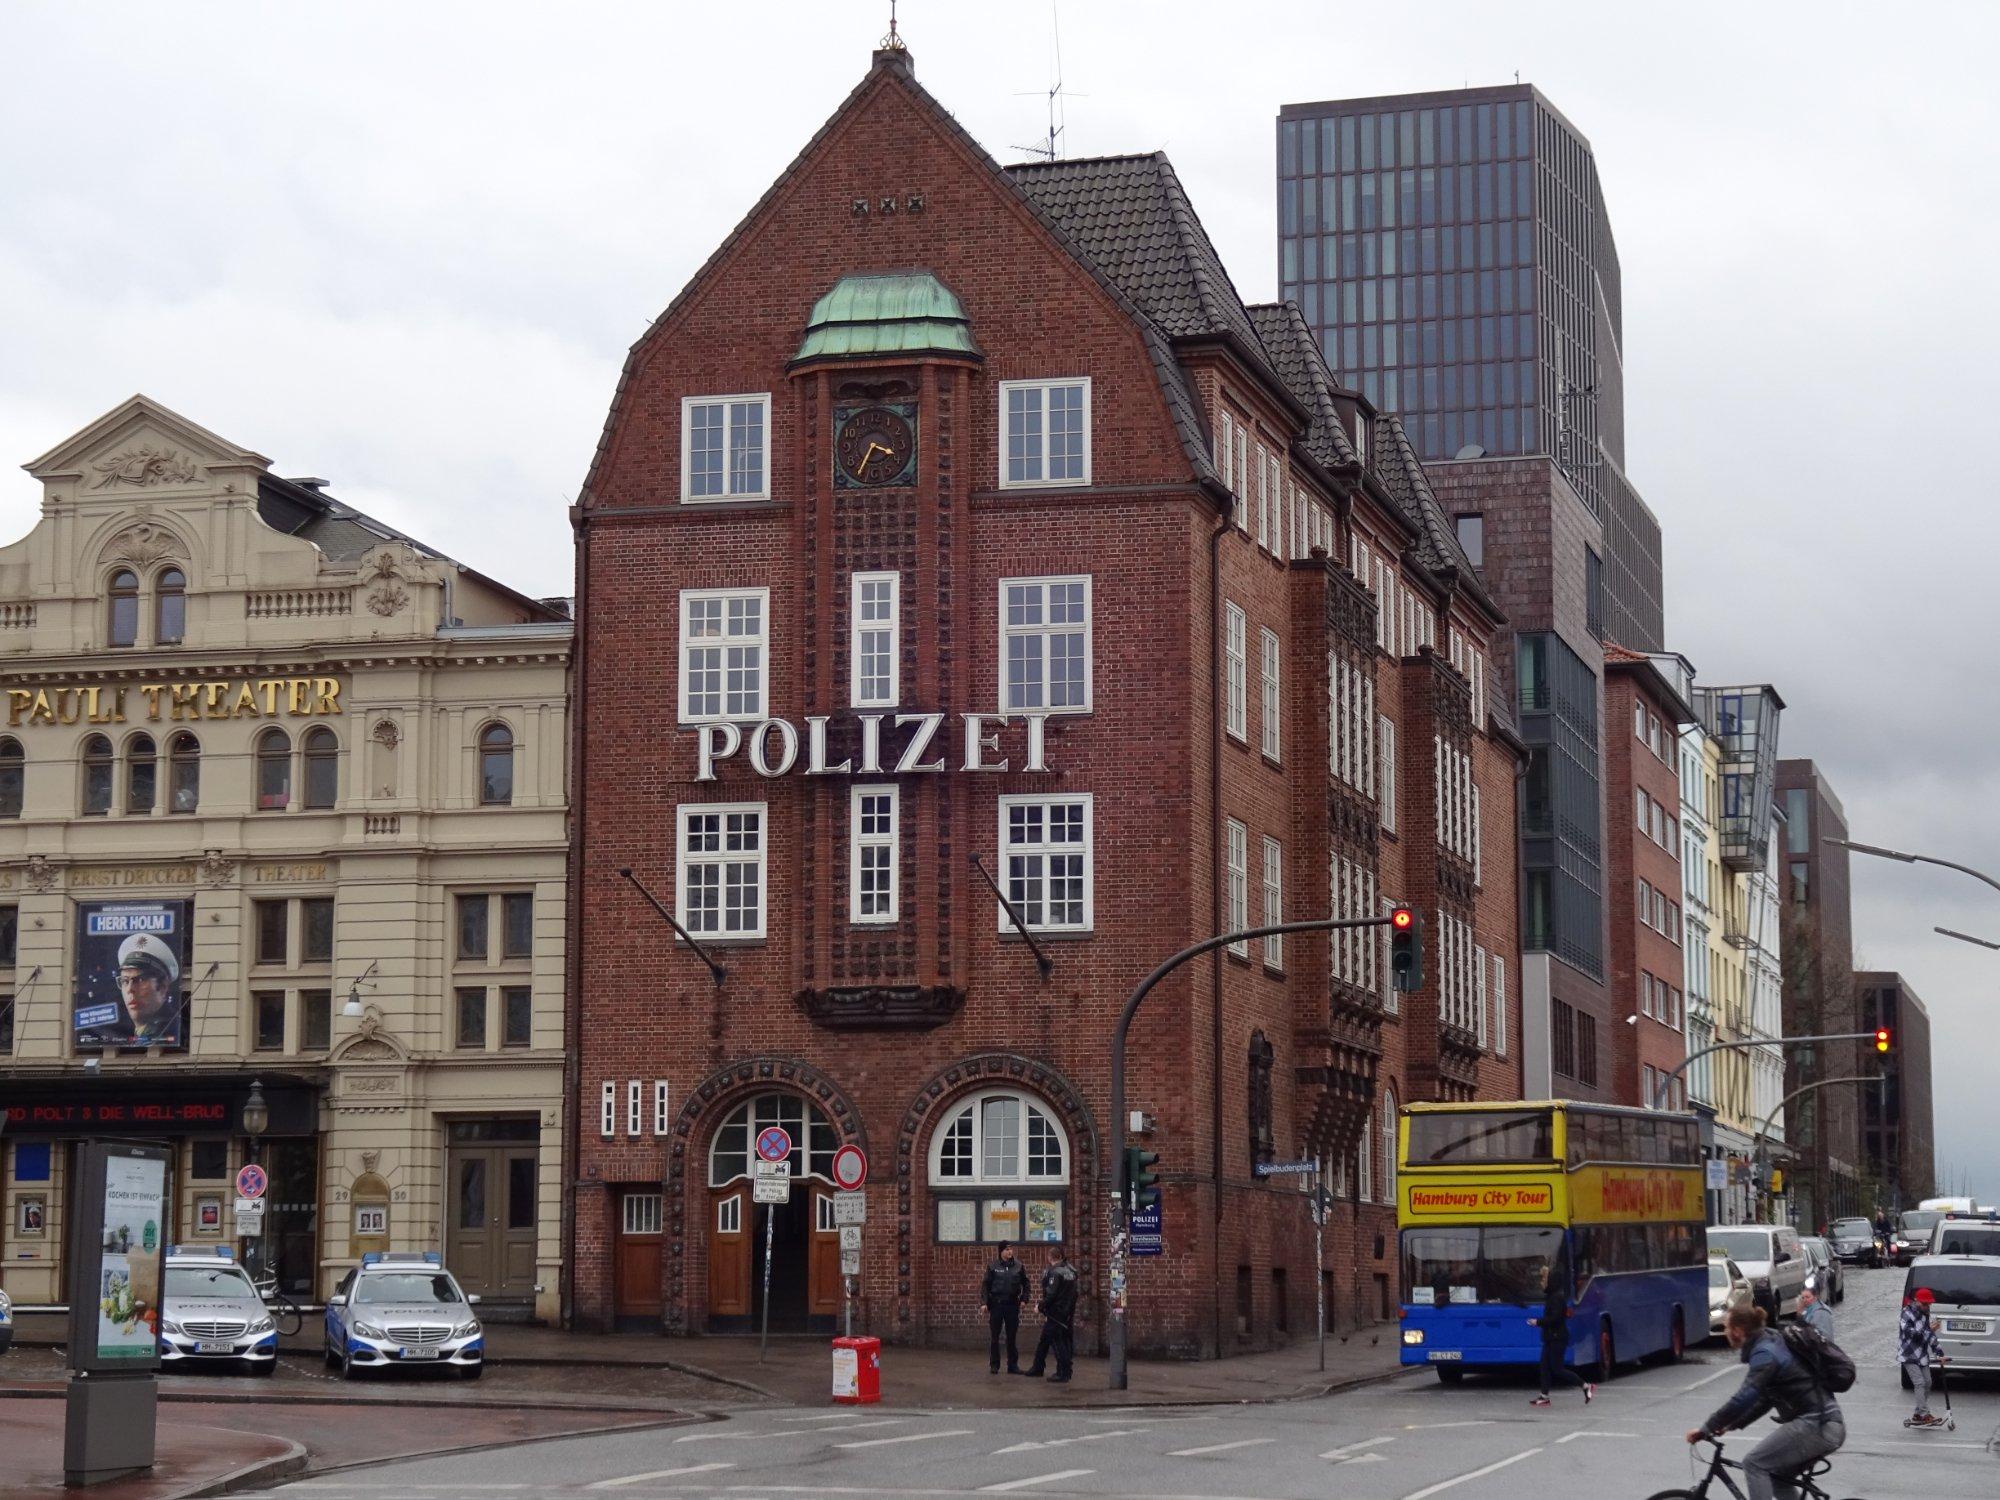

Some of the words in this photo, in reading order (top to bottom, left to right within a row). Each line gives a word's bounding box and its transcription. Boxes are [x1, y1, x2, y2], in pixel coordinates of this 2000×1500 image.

[6, 687, 129, 727] PAULI
[141, 677, 342, 721] THEATER
[694, 713, 1050, 782] POLIZEI
[70, 872, 121, 888] ERNST
[253, 864, 327, 882] THEATER
[97, 916, 127, 931] HERR
[129, 914, 165, 930] HOLM
[33, 1106, 73, 1121] POLT
[99, 1106, 124, 1120] DIE
[1258, 1163, 1313, 1175] Spielbudenplatz
[335, 1191, 349, 1201] 29
[394, 1191, 407, 1201] 30
[1412, 1192, 1478, 1207] Hamburg
[1483, 1191, 1512, 1205] City
[1516, 1190, 1549, 1205] Tour
